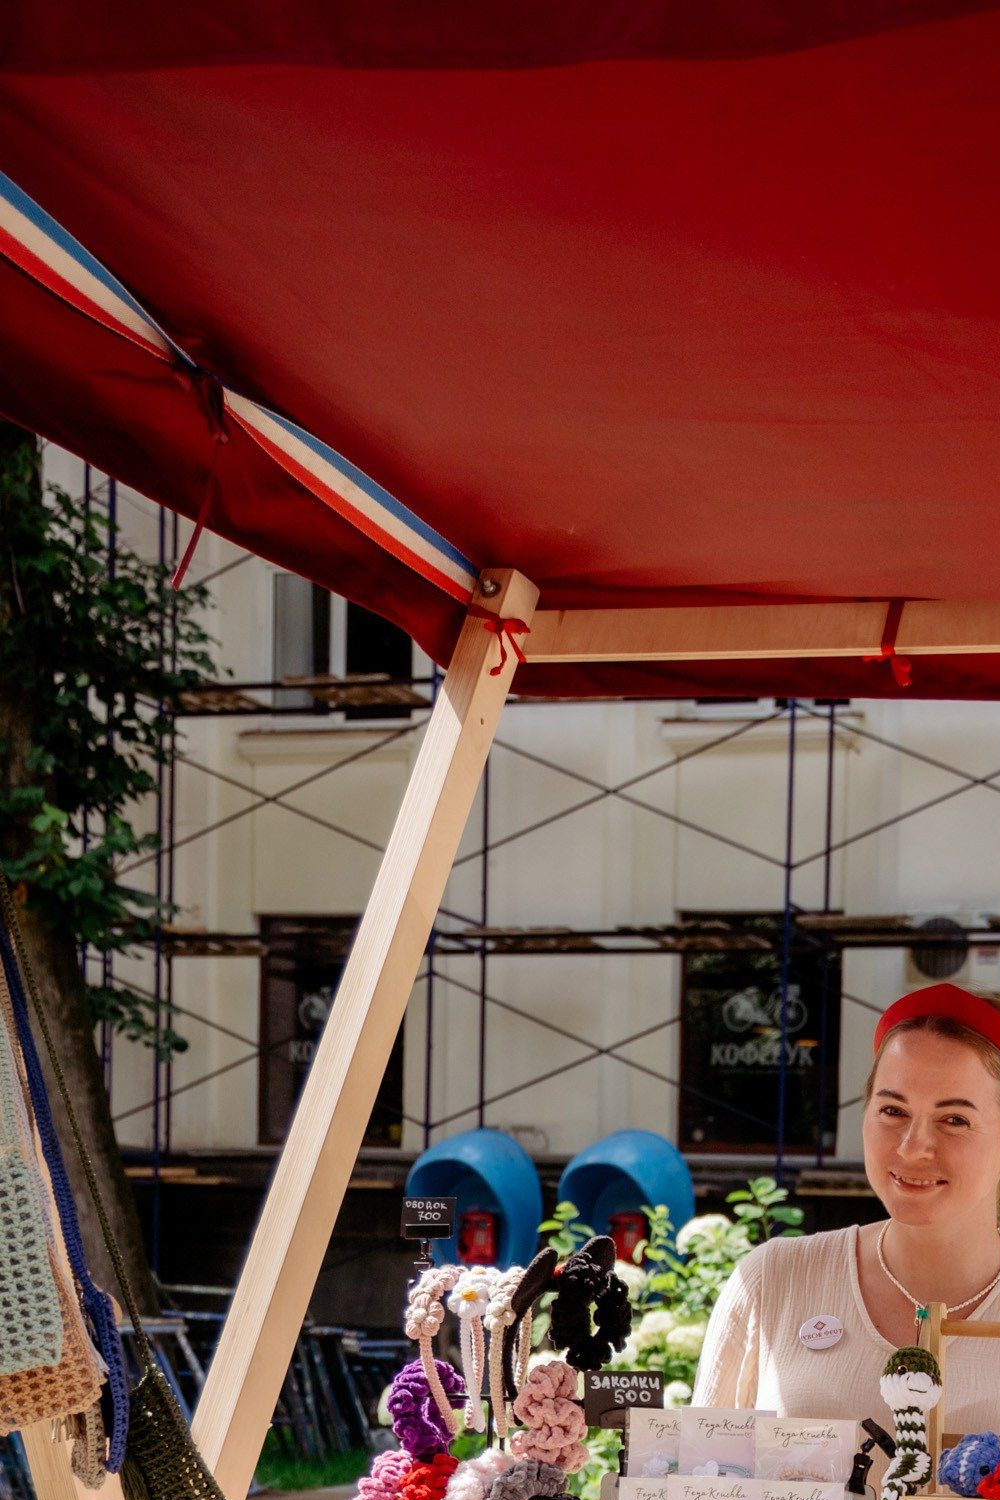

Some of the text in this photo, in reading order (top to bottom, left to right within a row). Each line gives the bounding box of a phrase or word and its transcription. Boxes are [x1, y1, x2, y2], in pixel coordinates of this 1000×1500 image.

[417, 1211, 442, 1221] 700
[590, 1375, 660, 1391] ЗАКОЛКИ
[614, 1389, 652, 1404] 500
